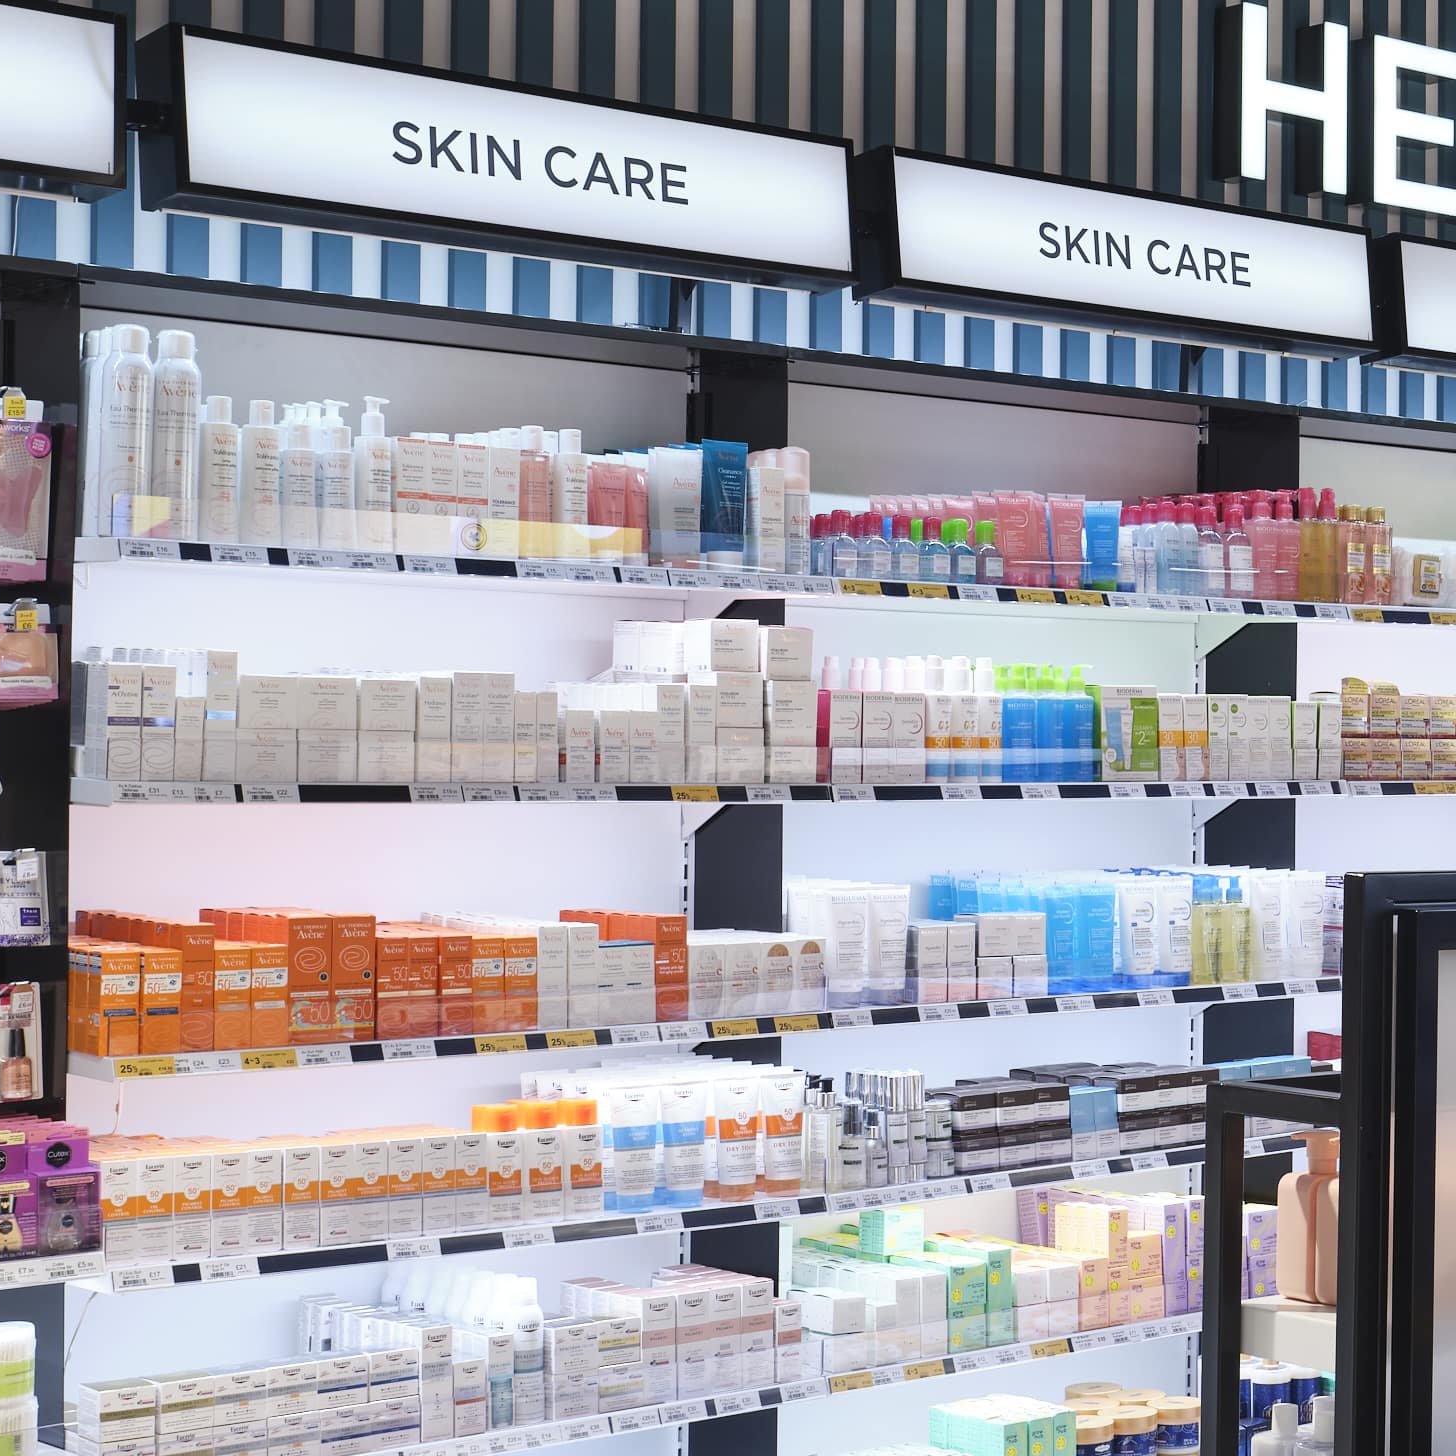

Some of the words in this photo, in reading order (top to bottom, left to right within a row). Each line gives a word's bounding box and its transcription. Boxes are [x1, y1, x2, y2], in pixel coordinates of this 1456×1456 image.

[393, 121, 522, 181] SKIN
[545, 146, 689, 205] CARE
[1038, 221, 1132, 270] SKIN
[1146, 239, 1252, 288] CARE
